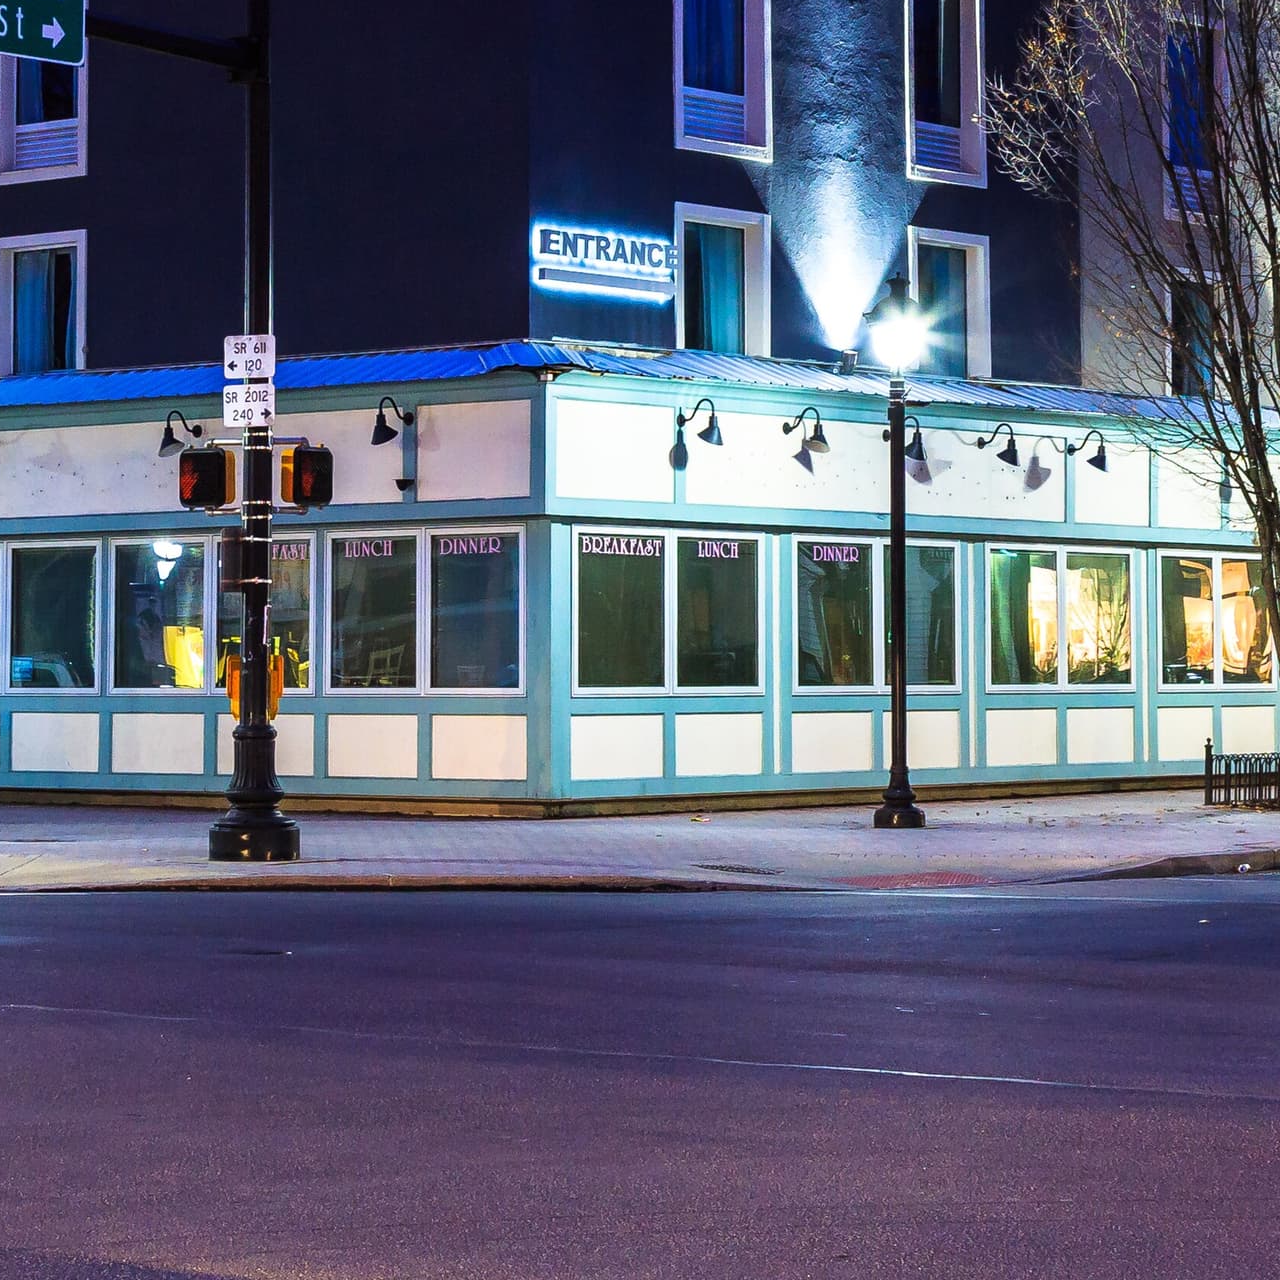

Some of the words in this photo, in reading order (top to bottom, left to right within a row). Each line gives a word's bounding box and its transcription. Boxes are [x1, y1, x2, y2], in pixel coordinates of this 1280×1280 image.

[539, 228, 679, 270] ENTRANCE
[234, 342, 247, 354] SR
[253, 342, 267, 354] 611
[244, 358, 262, 372] 120
[225, 391, 238, 404] SR
[244, 390, 269, 403] 2012
[232, 408, 254, 421] 240
[344, 539, 393, 558] LUNCH
[439, 536, 502, 556] DINNER
[581, 534, 662, 557] BREAKFAST
[697, 539, 739, 559] LUNCH
[812, 545, 859, 563] DINNER
